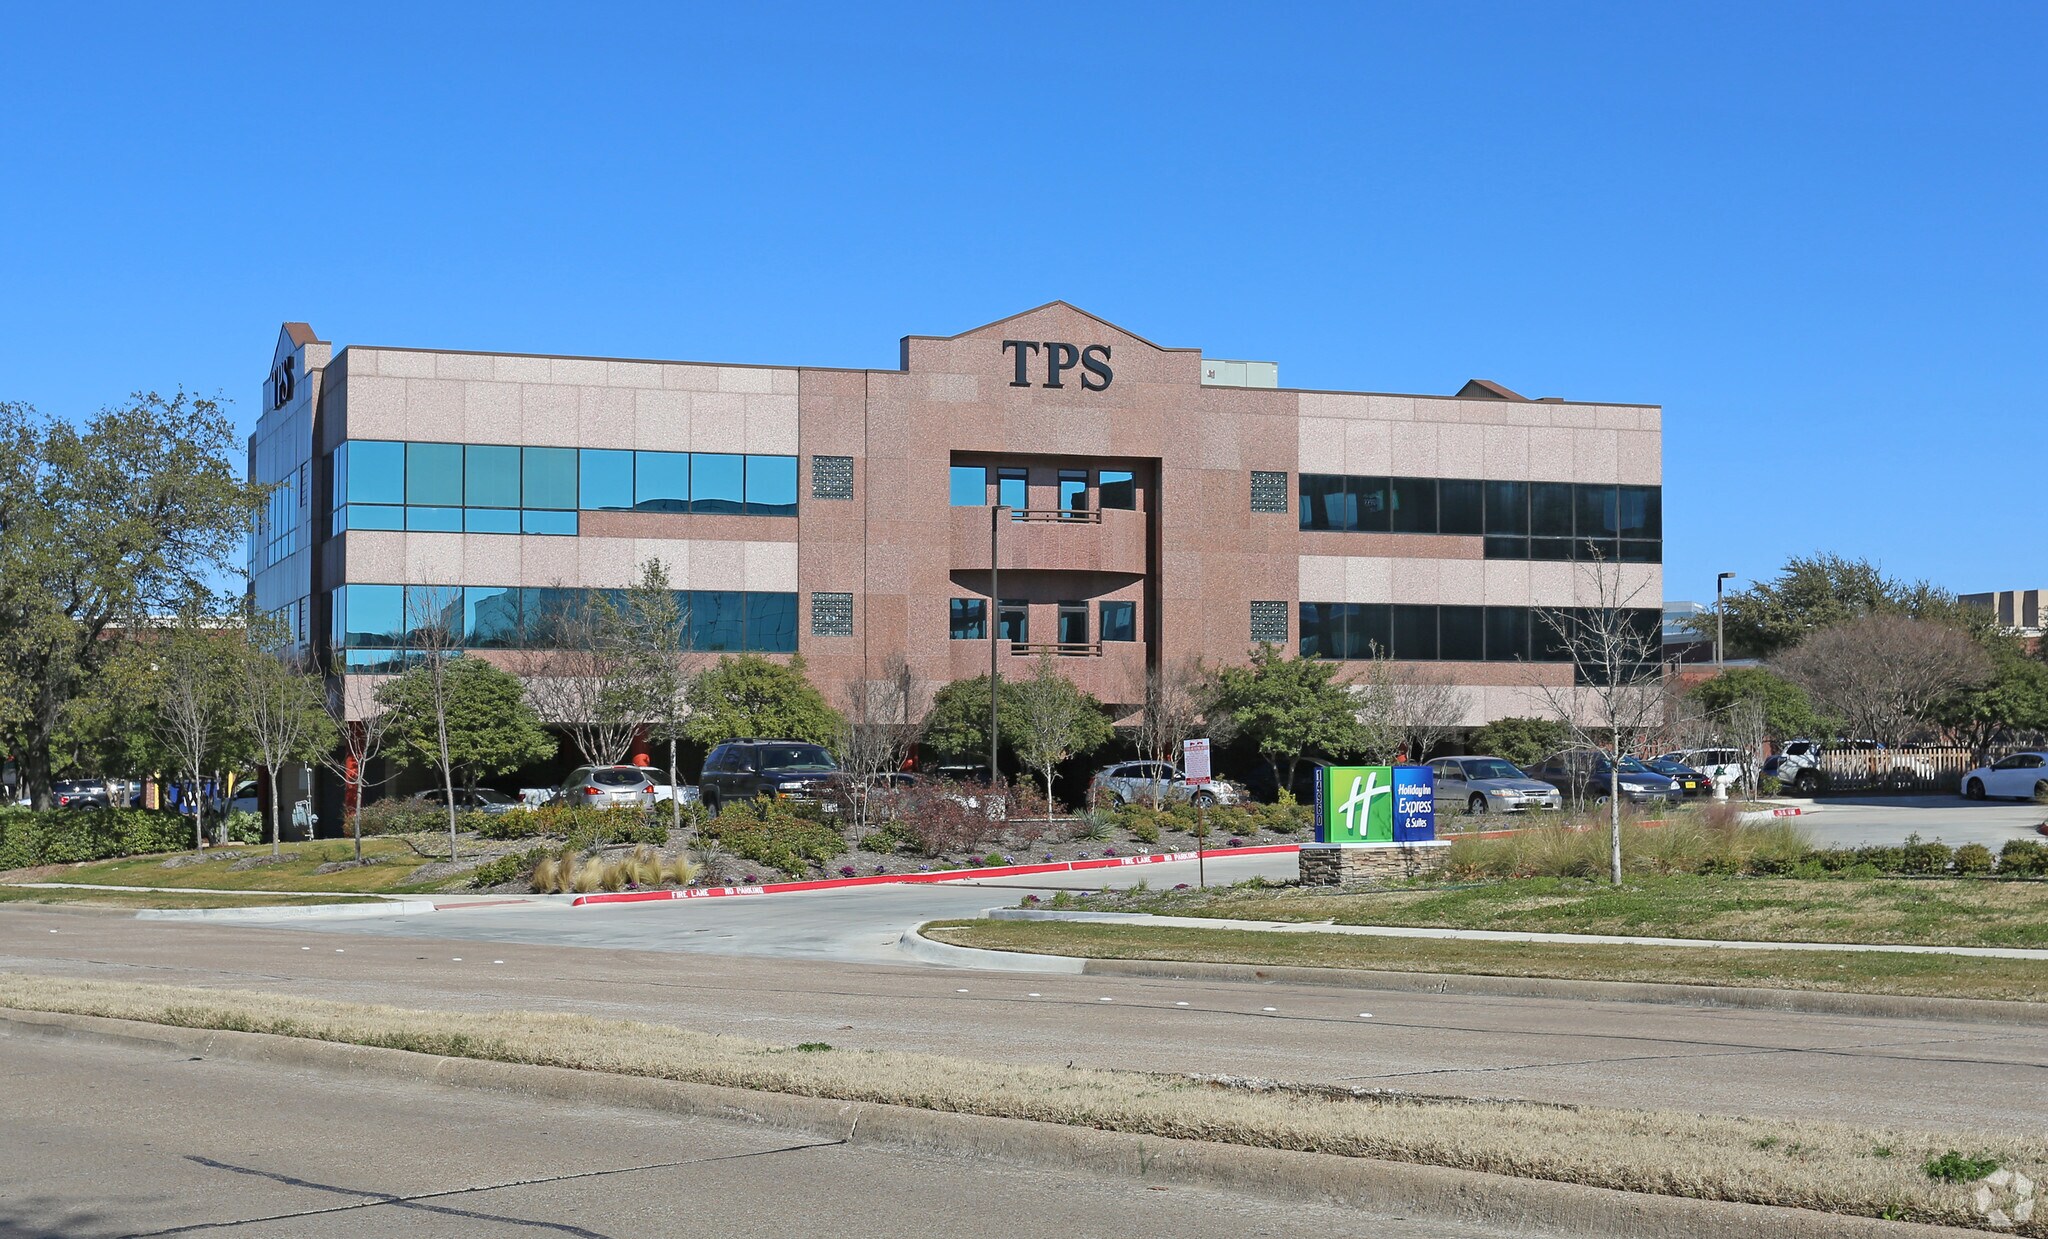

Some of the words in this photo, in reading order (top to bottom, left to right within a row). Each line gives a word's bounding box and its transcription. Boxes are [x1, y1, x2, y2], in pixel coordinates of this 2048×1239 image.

[1002, 340, 1113, 392] TPS
[1398, 784, 1422, 798] Holiday
[1422, 784, 1431, 794] Inn
[1399, 798, 1431, 817] Express
[1405, 818, 1411, 828] &
[1411, 817, 1427, 828] Suites
[1121, 857, 1134, 865] FIRE
[1137, 855, 1151, 863] LANE
[1164, 854, 1172, 862] NO
[1174, 851, 1198, 861] PARKING
[672, 890, 688, 899] FIRE
[691, 888, 709, 898] LANE
[724, 887, 734, 896] NO
[737, 886, 764, 895] PARKING
